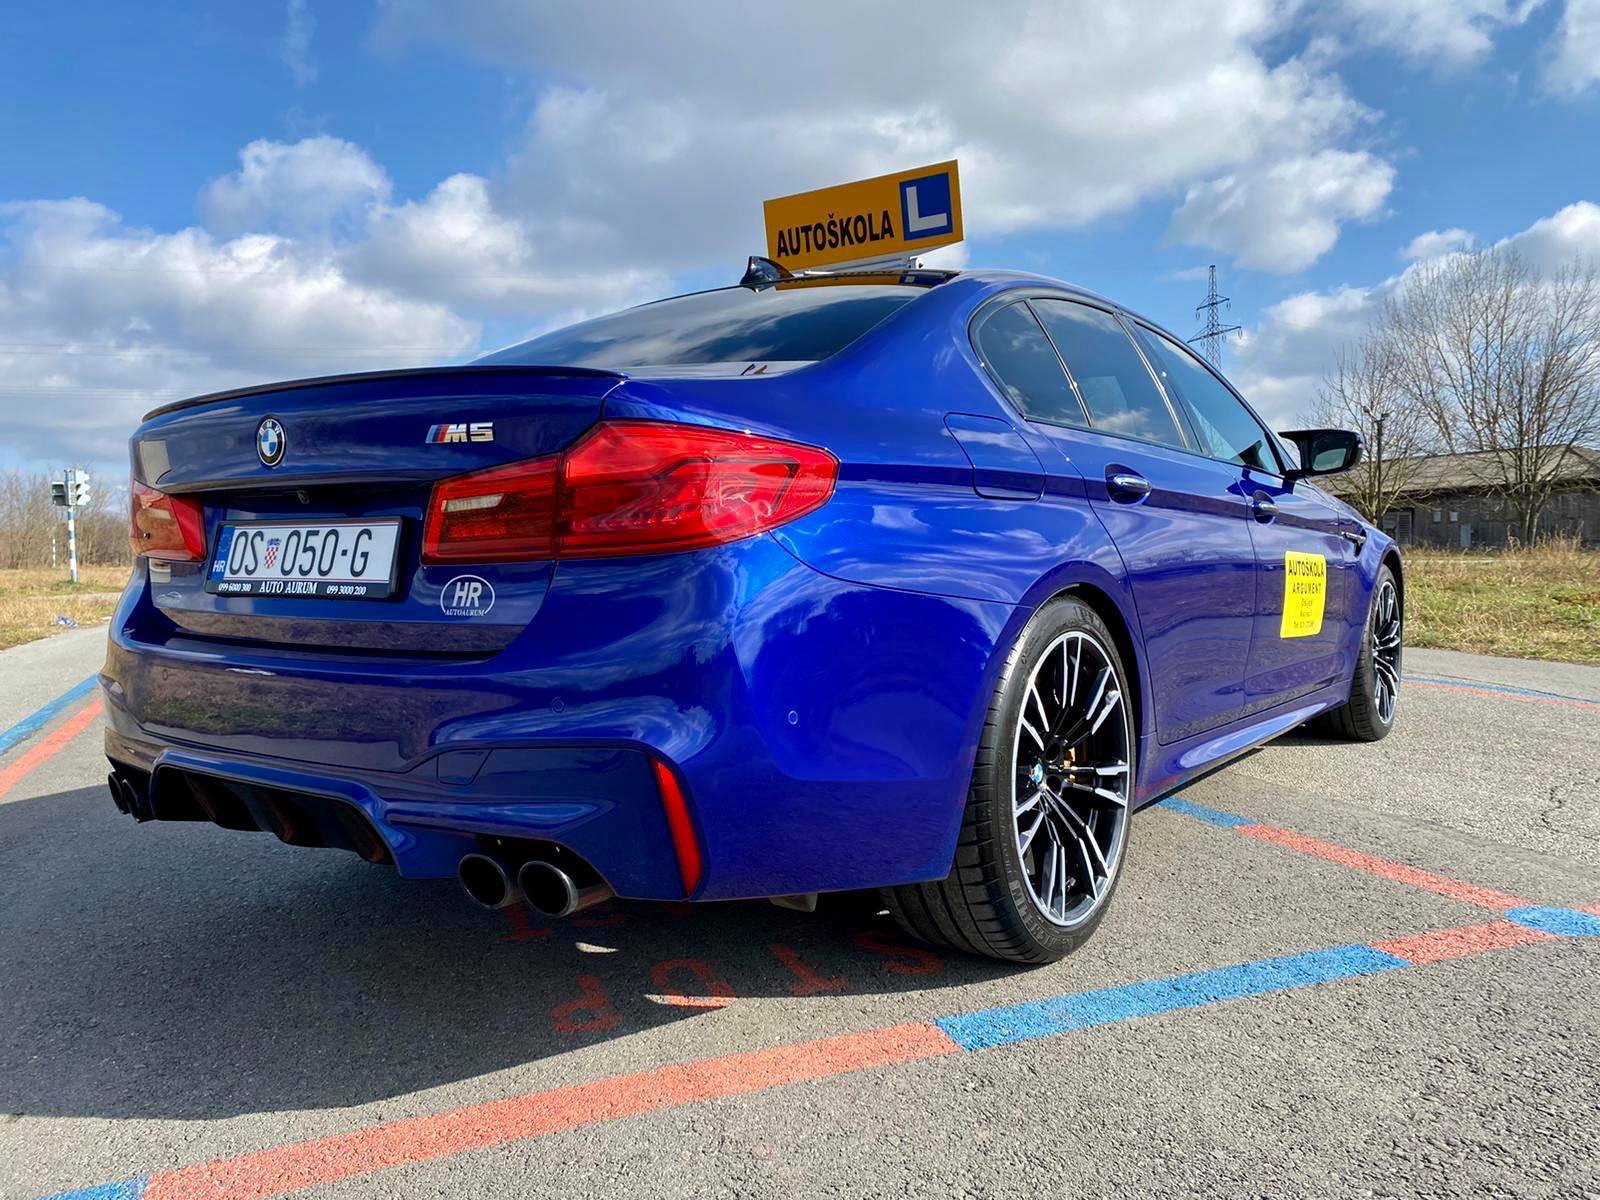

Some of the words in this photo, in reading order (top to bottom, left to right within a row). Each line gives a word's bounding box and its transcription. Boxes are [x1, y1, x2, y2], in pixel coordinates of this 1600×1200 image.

[905, 186, 948, 233] L
[776, 210, 895, 258] AUTOŠKOLA
[444, 422, 494, 442] M5
[229, 530, 264, 576] OS
[280, 528, 373, 577] 050-G
[213, 560, 225, 572] HR
[1288, 557, 1325, 577] AUTOŠKOLA
[259, 581, 284, 593] AUTO
[284, 581, 318, 594] AURUM
[326, 585, 338, 594] 099
[452, 581, 483, 608] HR
